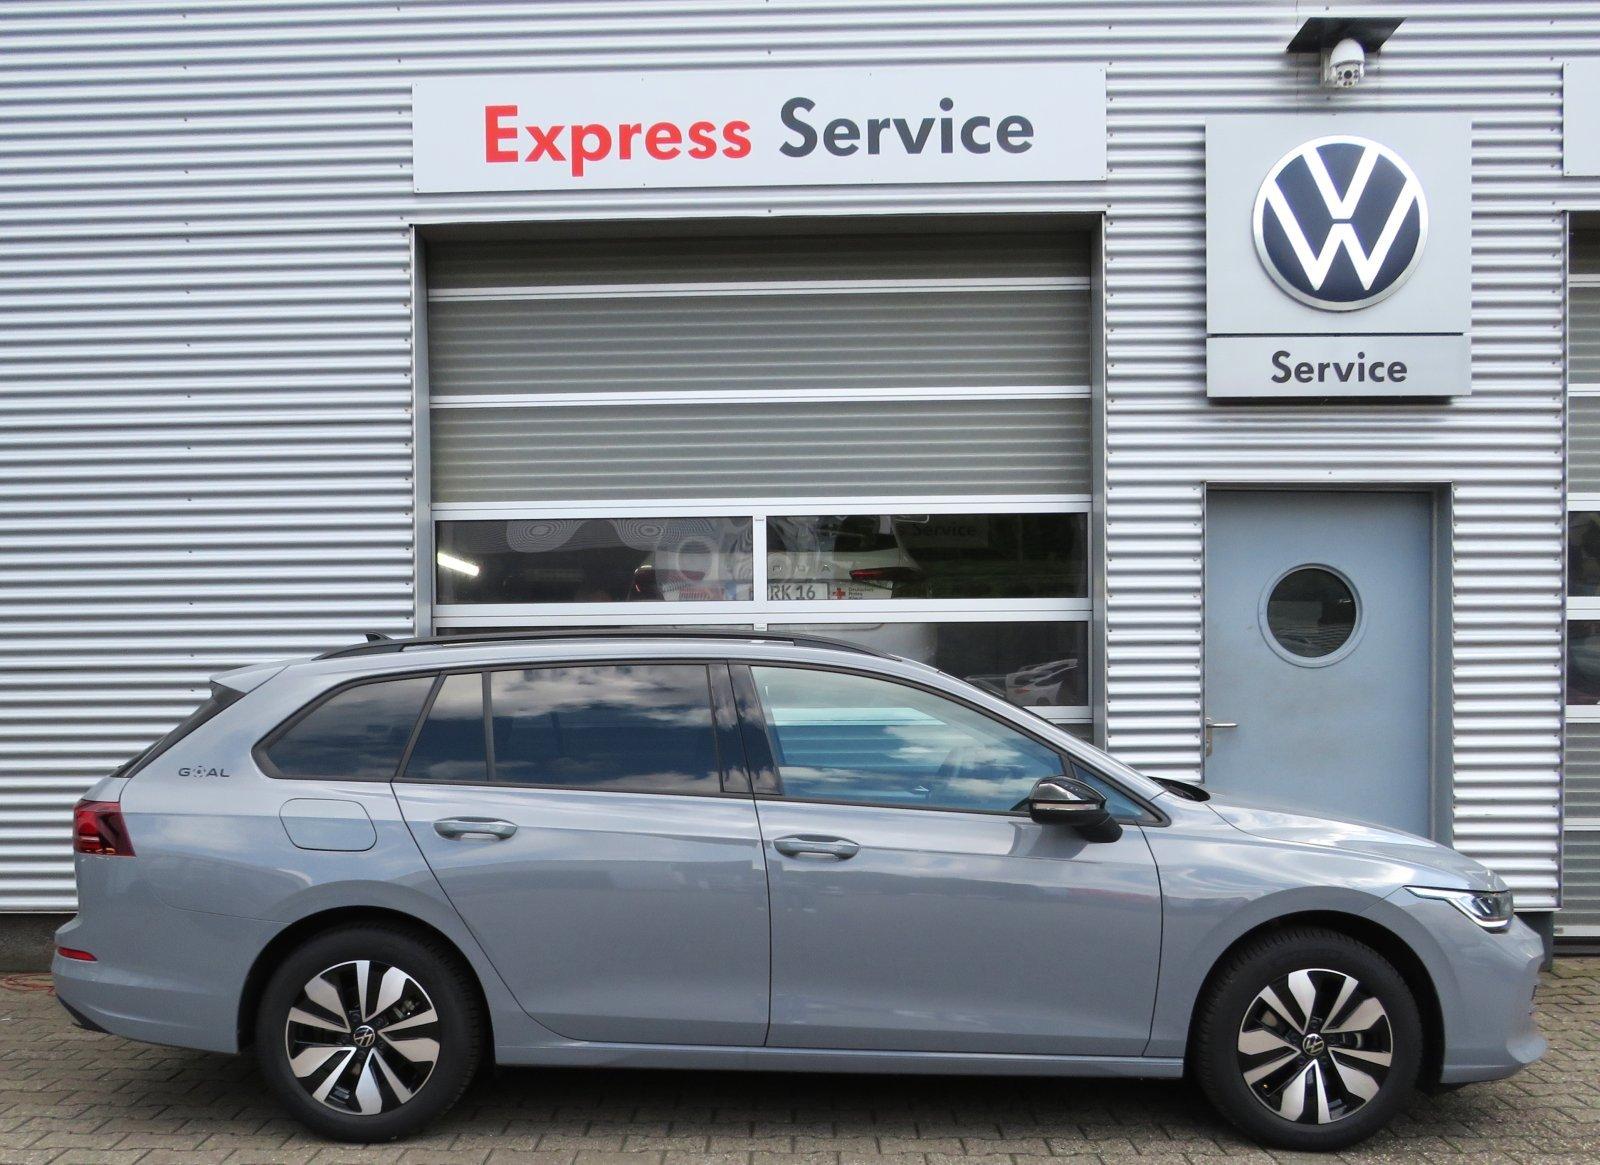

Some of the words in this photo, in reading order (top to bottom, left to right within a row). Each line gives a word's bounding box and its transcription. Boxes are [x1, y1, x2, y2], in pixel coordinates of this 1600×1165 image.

[485, 105, 752, 177] Express
[779, 97, 1034, 158] Service
[1257, 138, 1424, 298] VW
[1271, 350, 1408, 384] Service
[795, 584, 816, 600] 16
